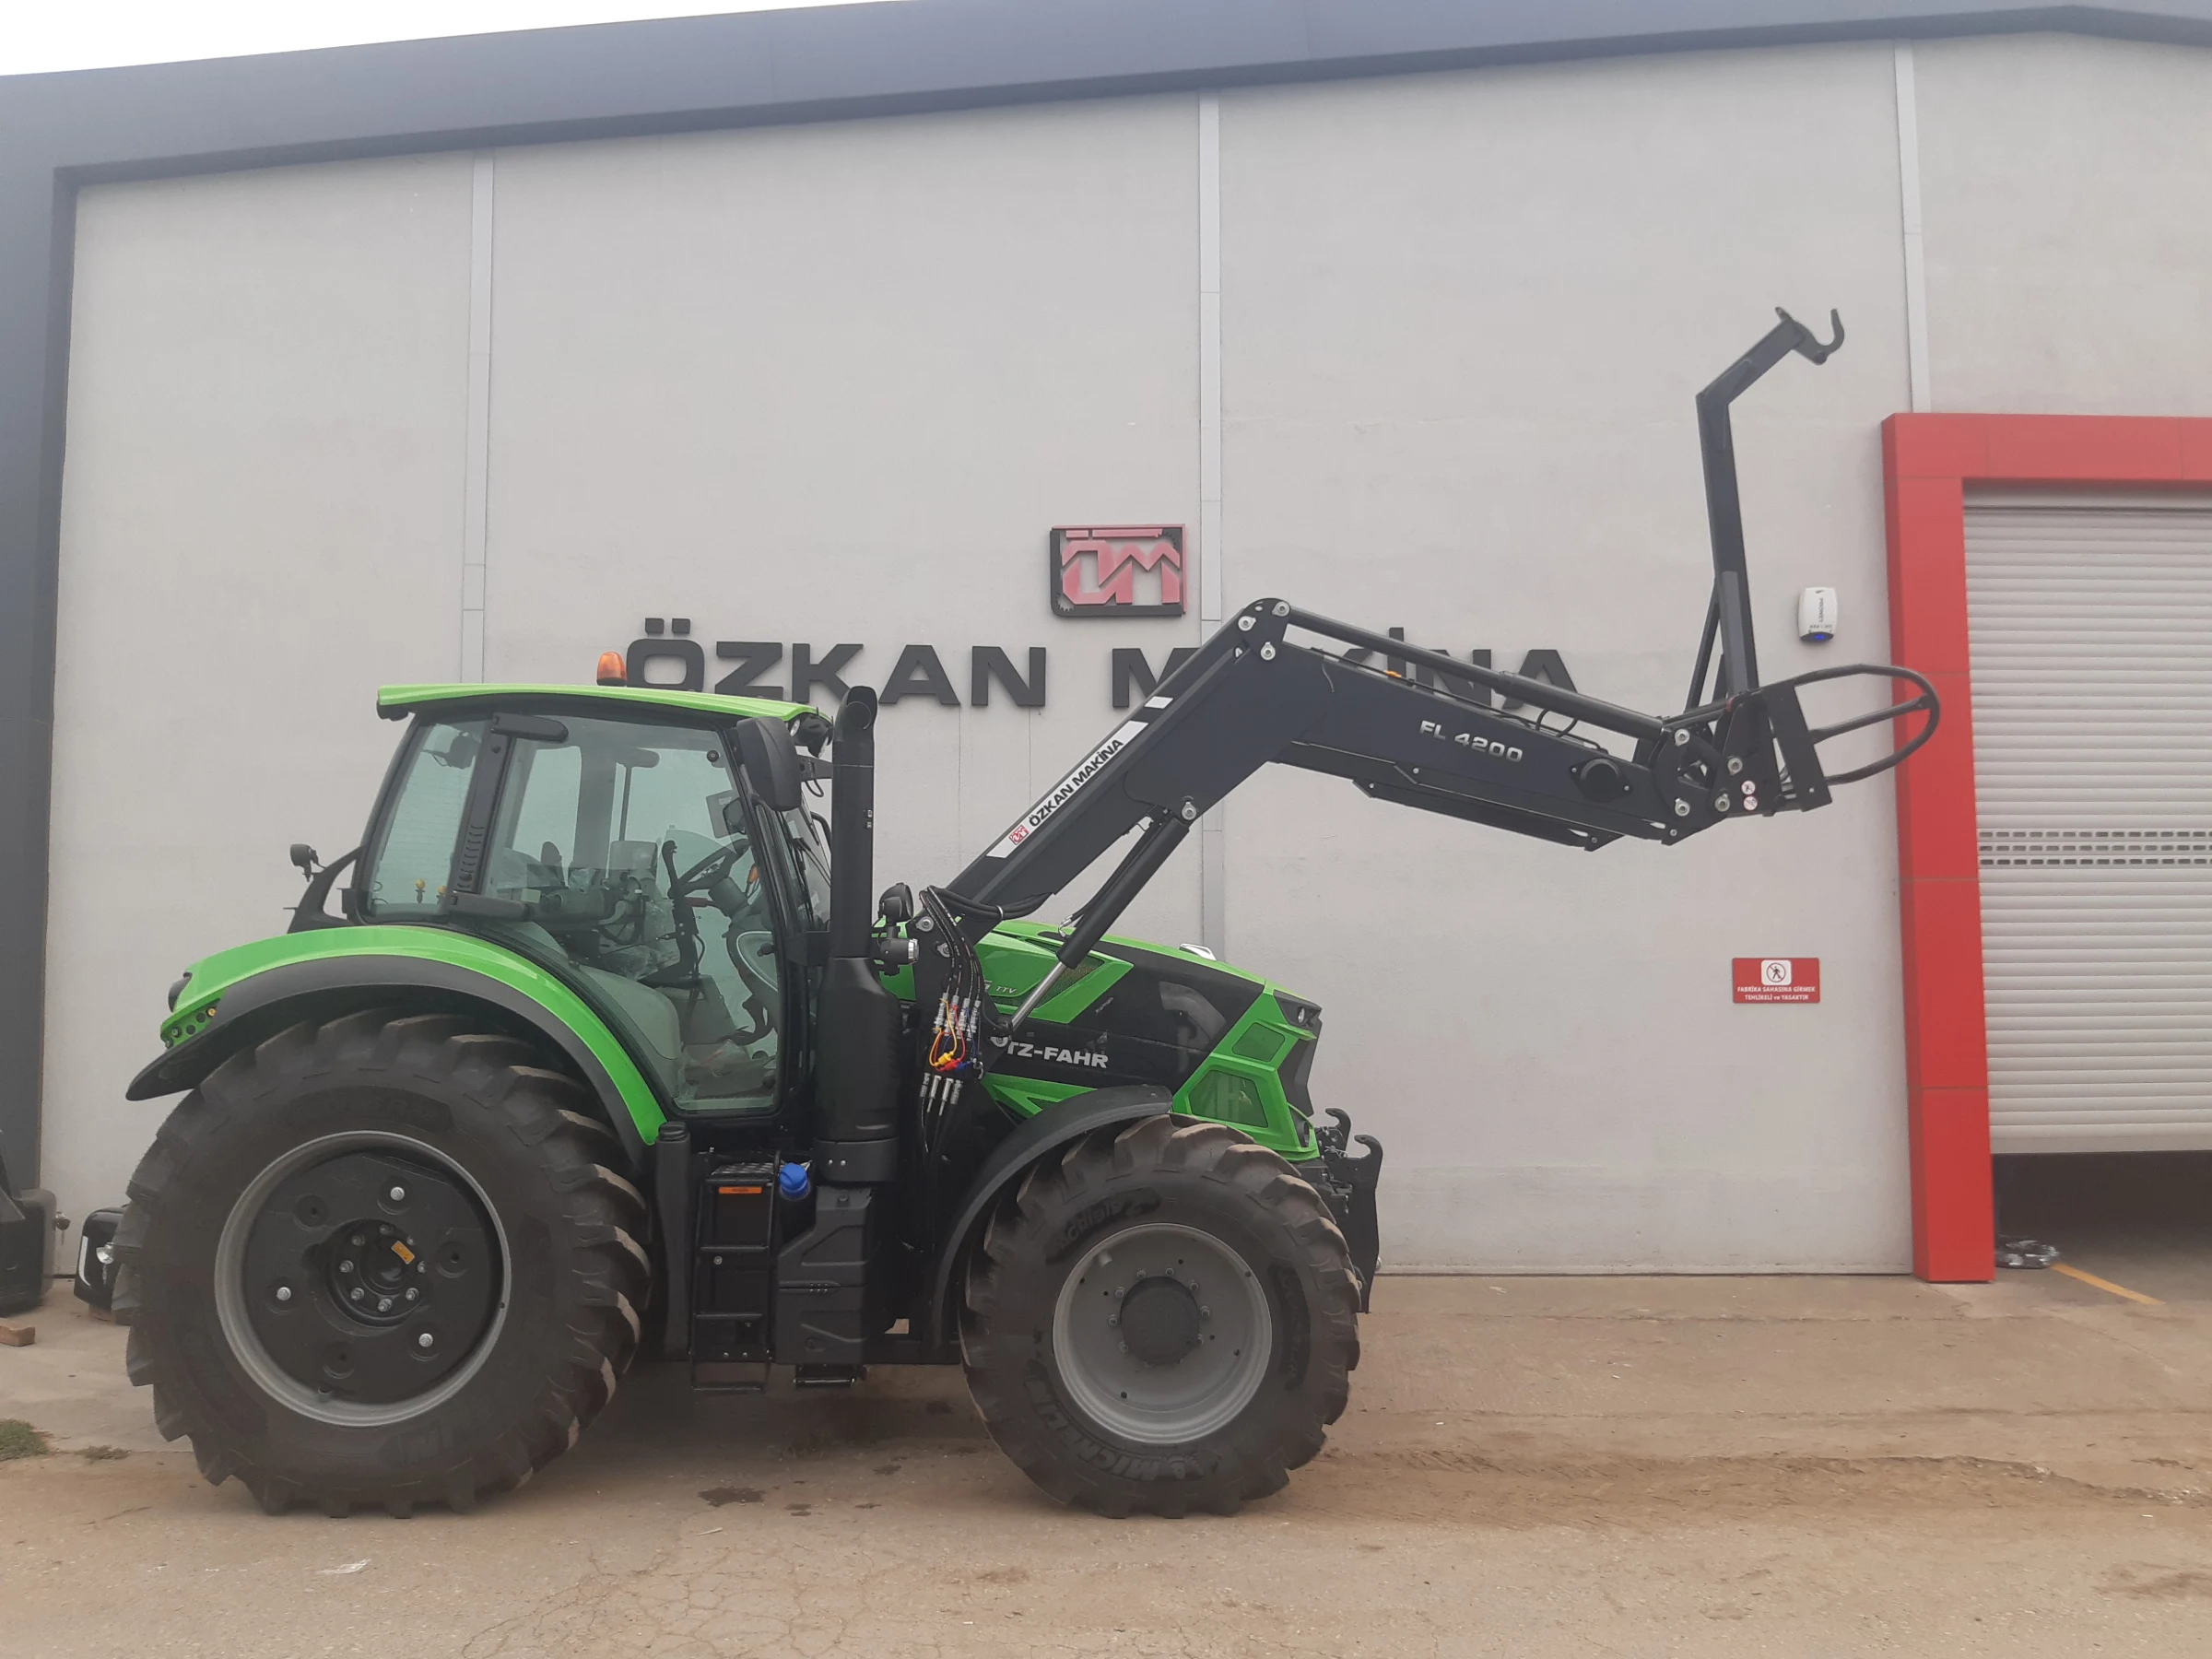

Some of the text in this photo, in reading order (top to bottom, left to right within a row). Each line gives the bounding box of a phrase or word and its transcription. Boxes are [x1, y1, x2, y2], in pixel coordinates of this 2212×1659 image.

[626, 617, 1047, 708] ÖZKAN
[1419, 720, 1524, 763] FL 4200
[1028, 783, 1075, 827] ÖZKAN
[1071, 739, 1124, 787] MAKİNA
[995, 985, 1017, 994] TTV
[1007, 1041, 1109, 1068] TZ-FAHR
